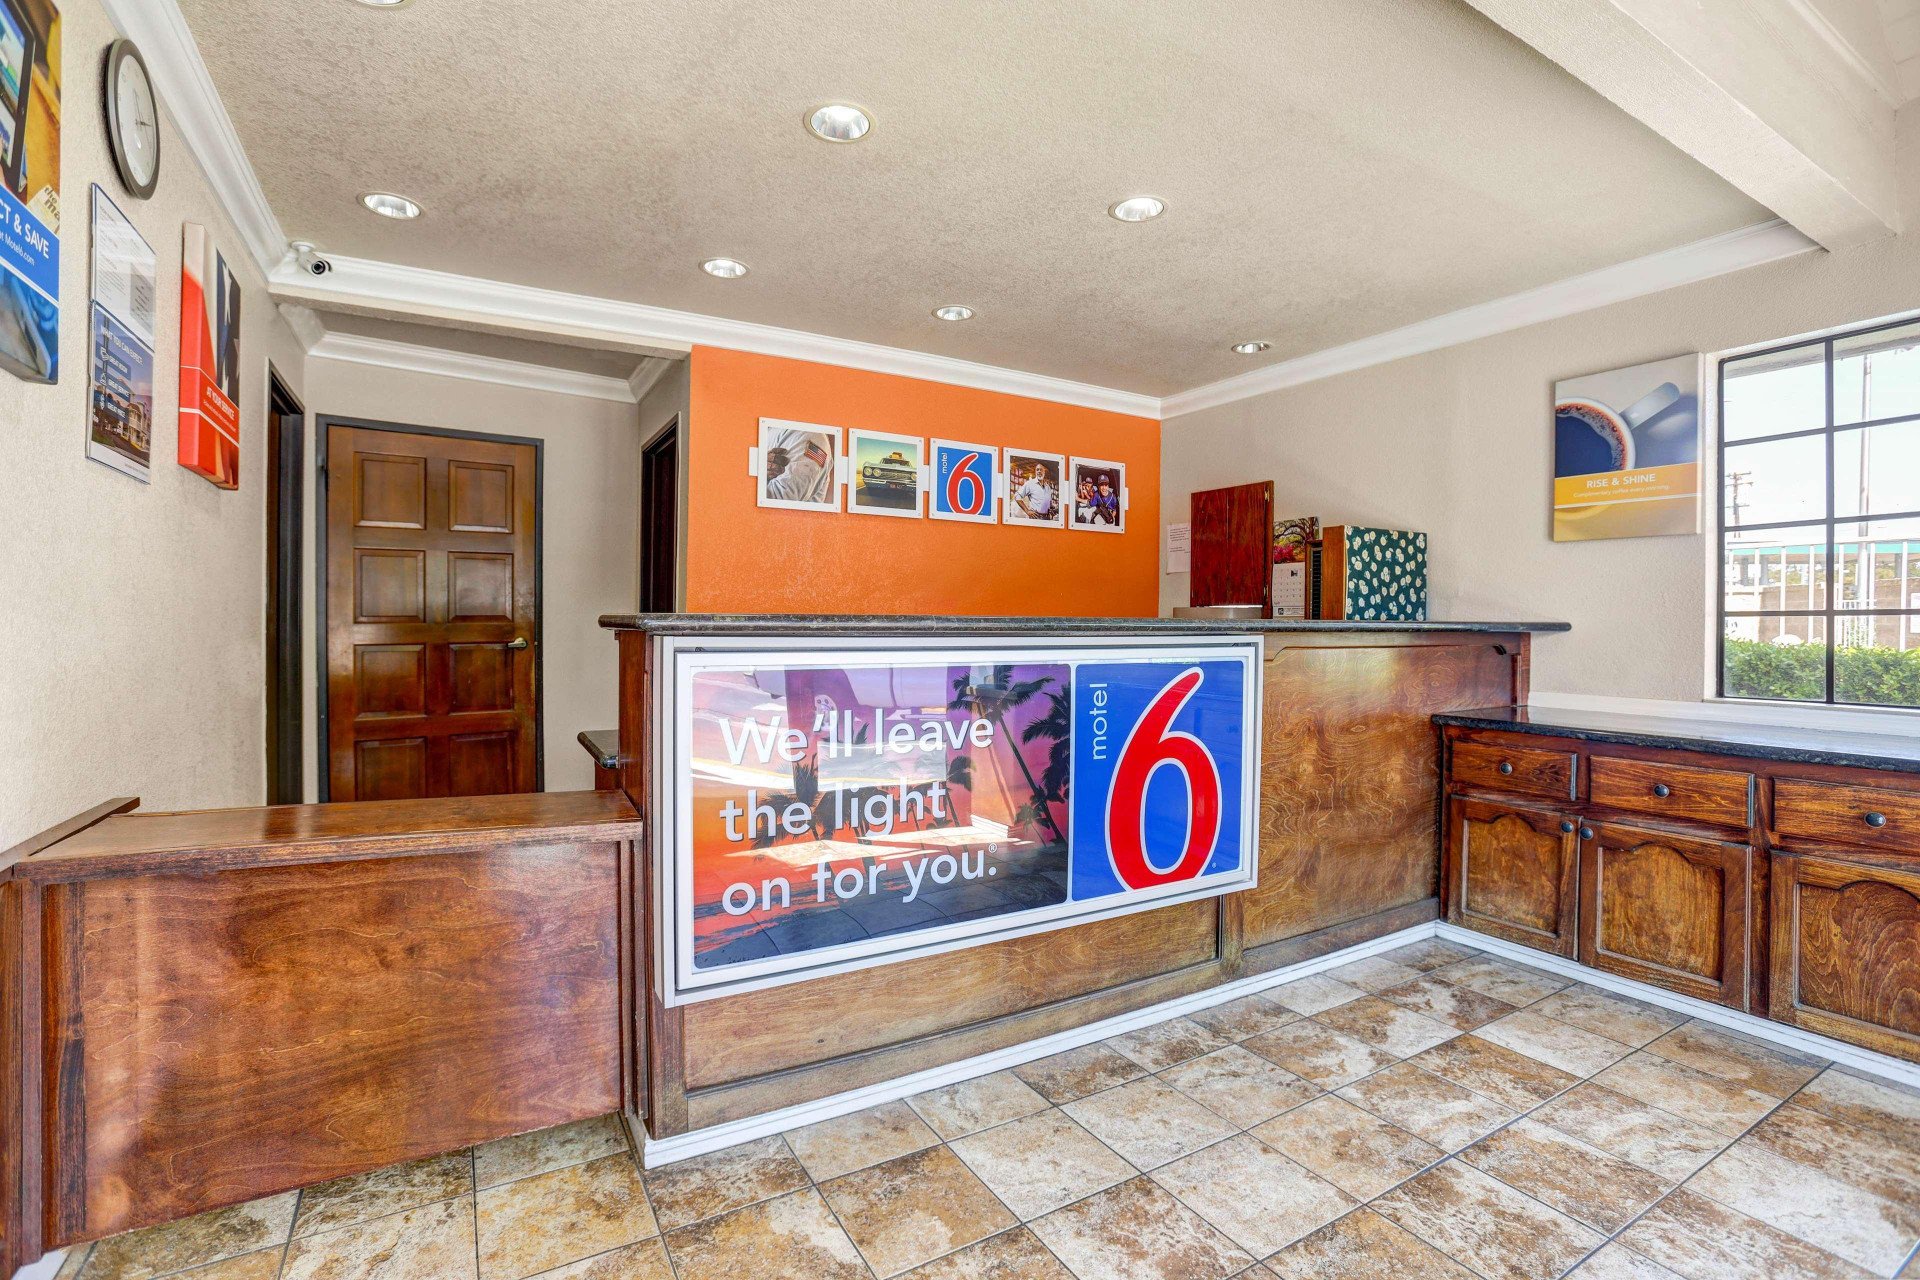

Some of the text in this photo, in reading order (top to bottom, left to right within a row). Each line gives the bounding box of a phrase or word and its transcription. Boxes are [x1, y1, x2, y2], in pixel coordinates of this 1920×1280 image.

[5, 233, 35, 267] Motel6.com
[13, 213, 22, 236] &
[24, 223, 50, 260] SAVE
[946, 452, 986, 515] 6
[1573, 489, 1611, 498] Complimentary
[1586, 473, 1656, 489] RISE & SHINE
[718, 707, 995, 766] We'll leave
[1089, 682, 1108, 761] motel
[1104, 666, 1223, 892] 6
[719, 776, 947, 843] the light
[721, 875, 791, 917] on
[811, 855, 887, 903] for
